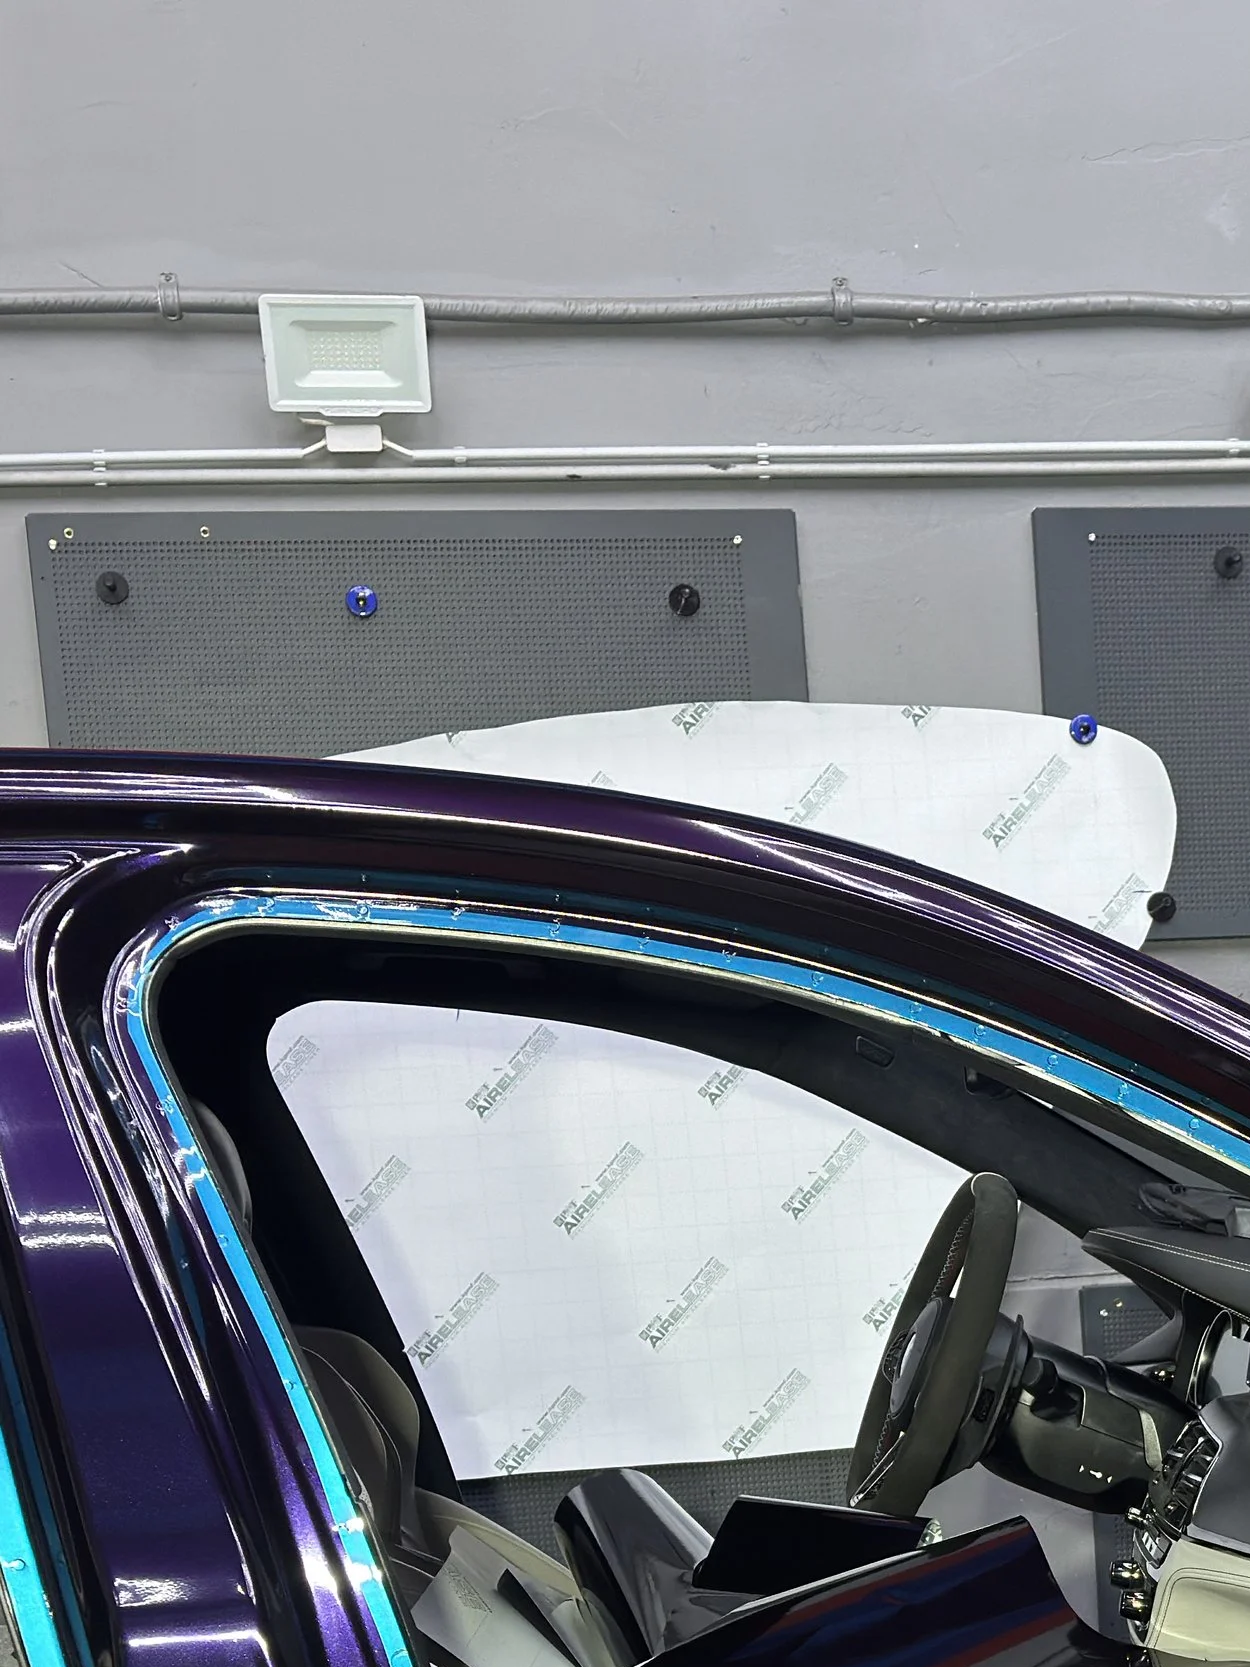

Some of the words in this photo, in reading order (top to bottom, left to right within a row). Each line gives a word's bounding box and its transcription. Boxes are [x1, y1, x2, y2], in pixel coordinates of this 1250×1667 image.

[476, 1026, 554, 1119] AIRELEASE
[563, 1144, 641, 1235] AIRELEASE
[791, 1130, 867, 1220] AIRELEASE
[418, 1273, 496, 1366] AIRELEASE
[649, 1258, 725, 1350] AIRELEASE
